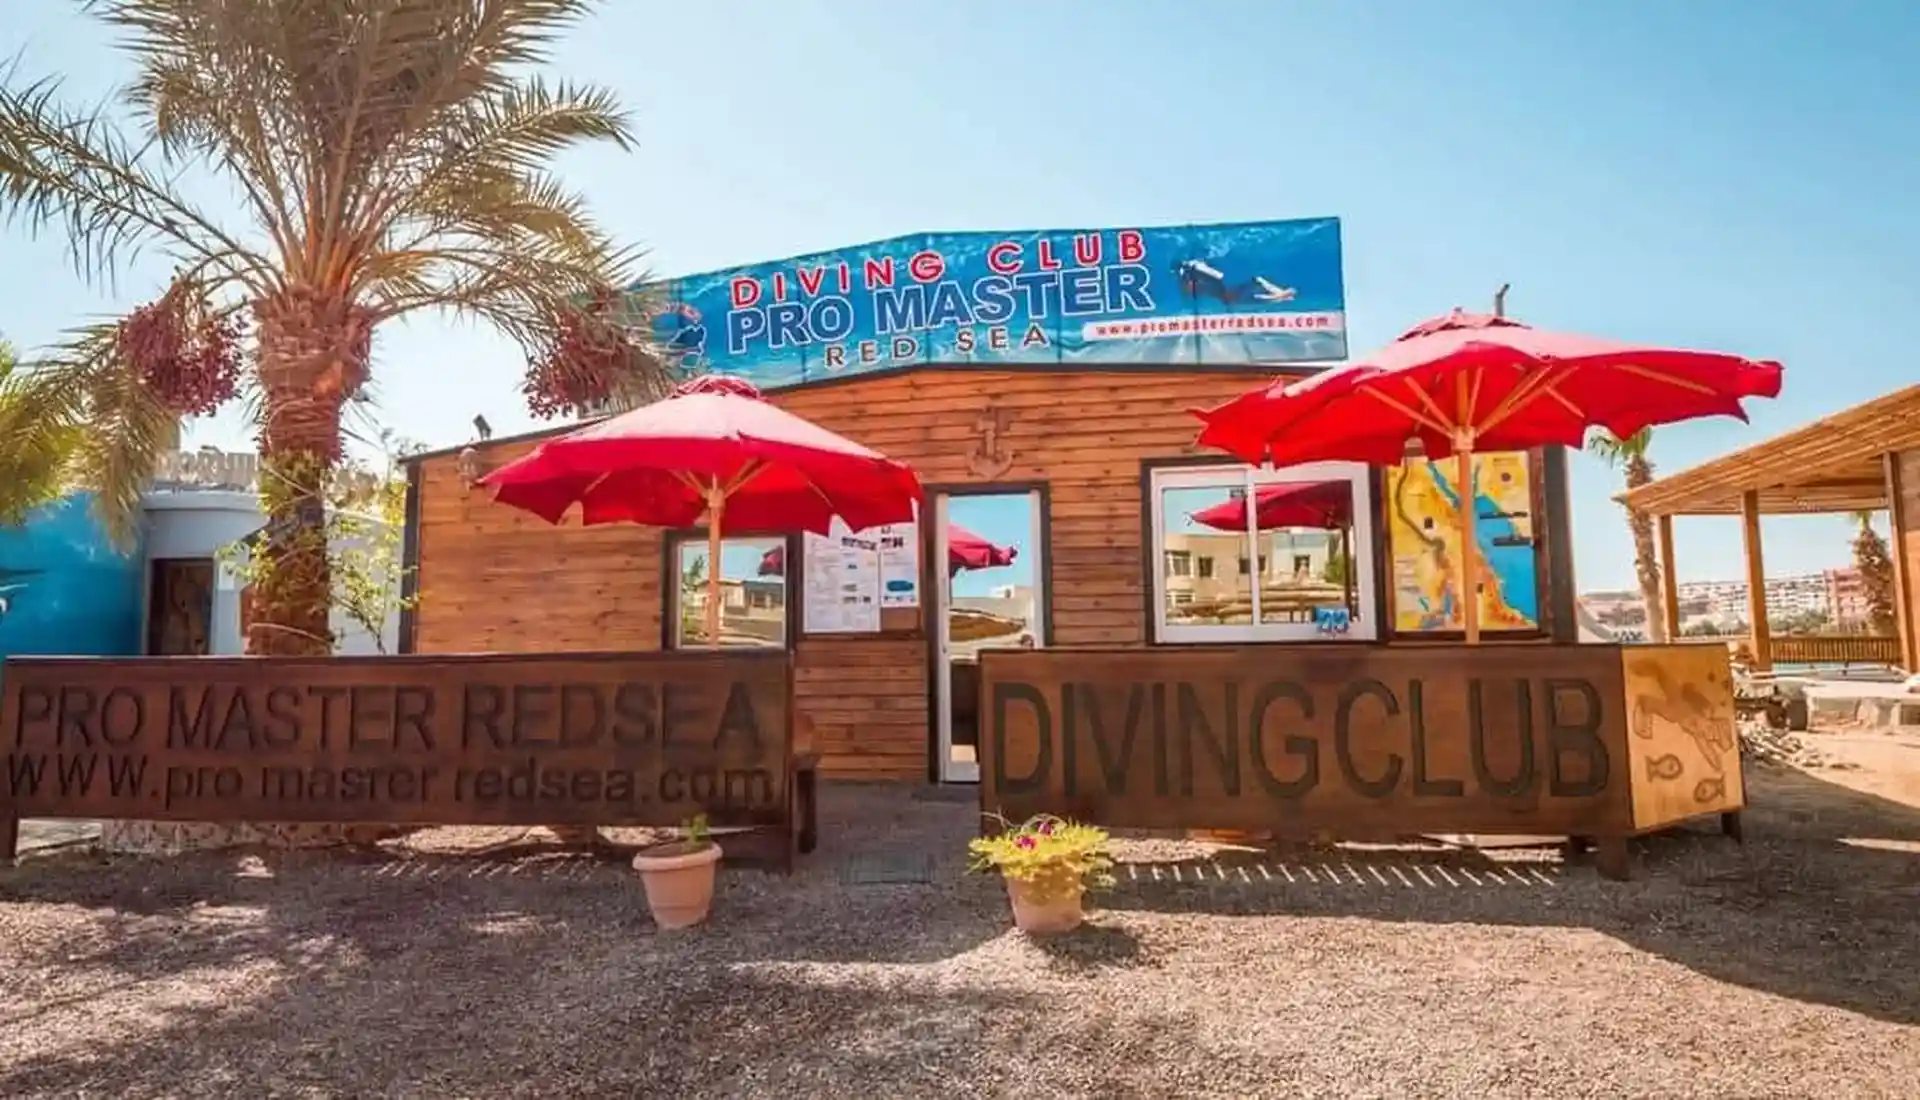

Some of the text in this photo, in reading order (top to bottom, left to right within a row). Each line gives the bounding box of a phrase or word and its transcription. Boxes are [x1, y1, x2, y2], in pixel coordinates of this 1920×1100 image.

[731, 230, 1144, 308] DIVING CLUB
[727, 264, 1155, 354] PRO MASTER
[1095, 314, 1330, 336] www.promasterredsea.com
[825, 322, 1050, 370] RED SEA
[16, 684, 144, 748] PRO
[165, 684, 437, 751] MASTER
